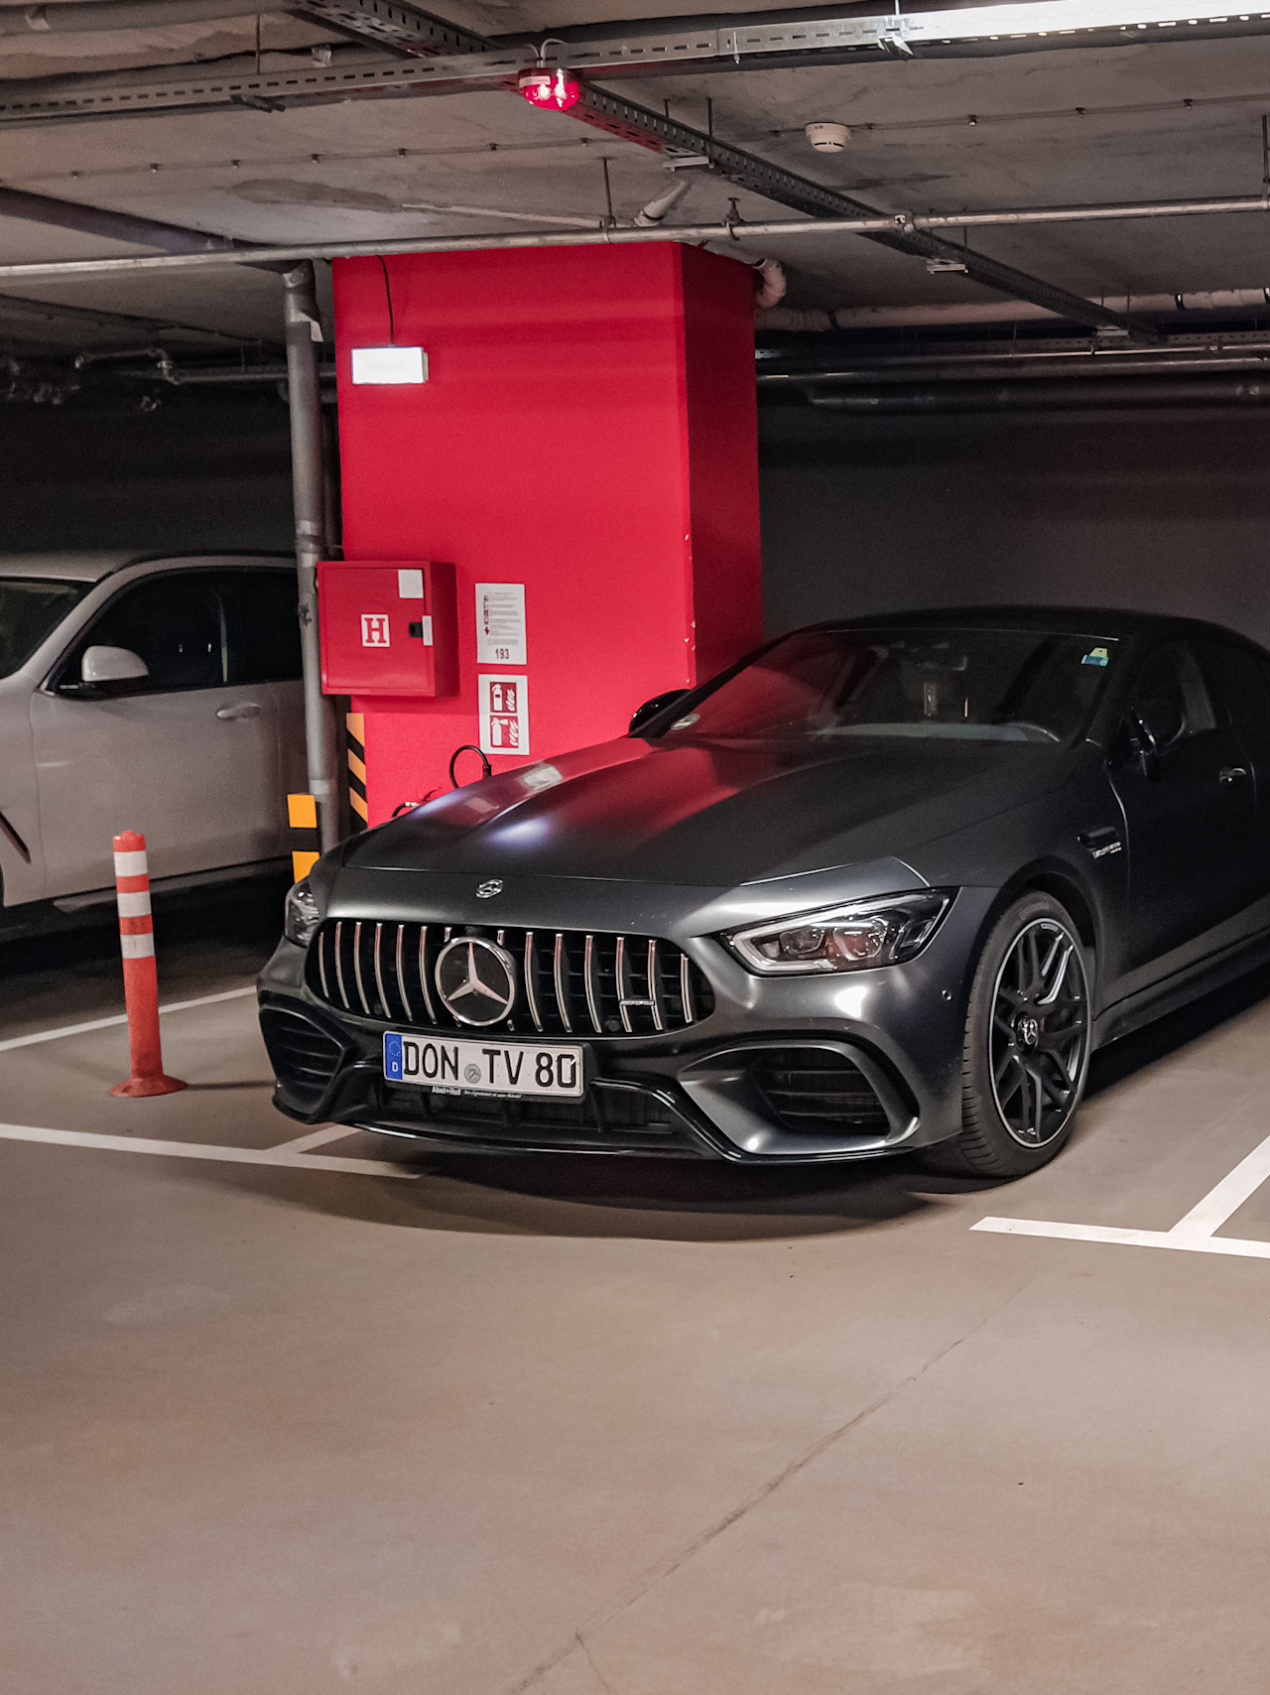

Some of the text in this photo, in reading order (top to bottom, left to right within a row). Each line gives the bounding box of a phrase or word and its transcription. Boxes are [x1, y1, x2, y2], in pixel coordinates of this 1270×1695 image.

[364, 617, 387, 643] H
[495, 648, 510, 660] 193
[391, 1041, 577, 1089] D DON TV 80
